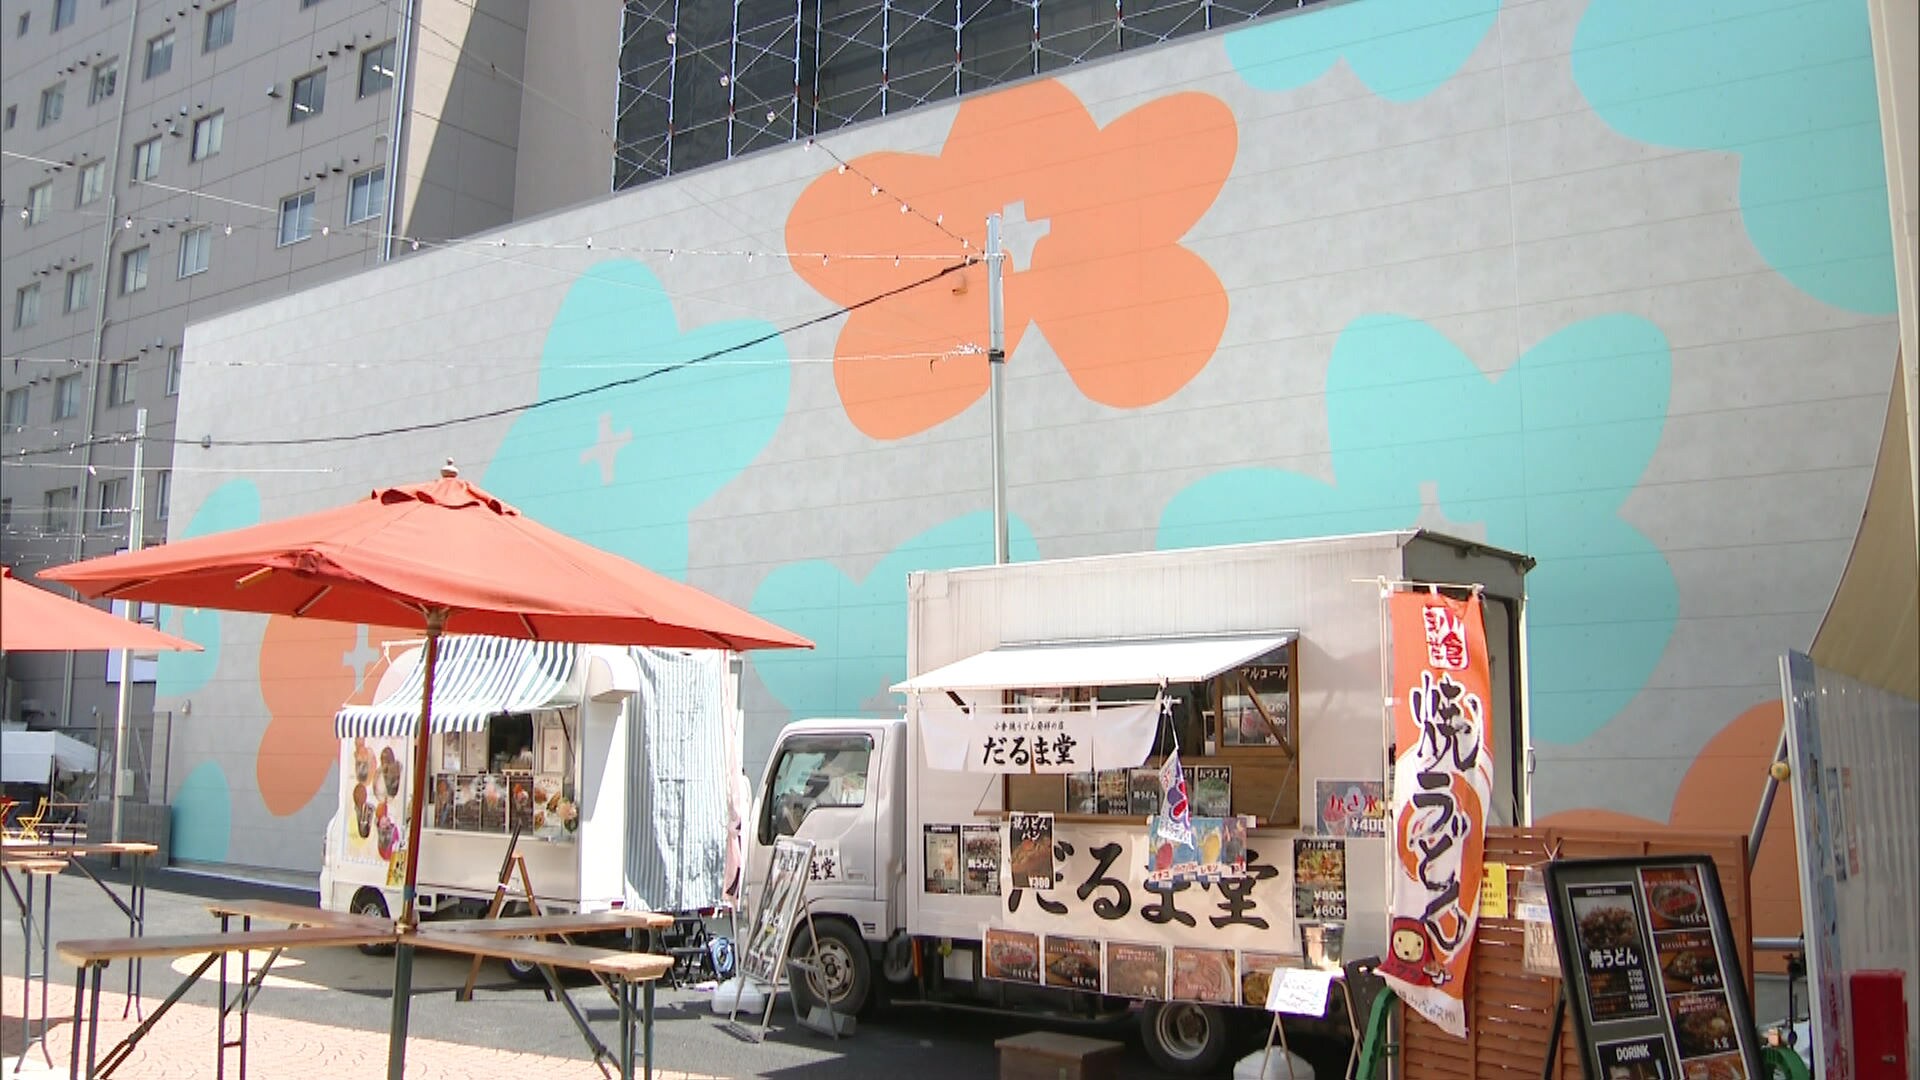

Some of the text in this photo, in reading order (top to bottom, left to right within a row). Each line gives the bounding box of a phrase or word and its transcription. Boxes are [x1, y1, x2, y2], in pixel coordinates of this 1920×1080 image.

[1241, 666, 1289, 681] アルコール
[983, 733, 1077, 766] だるま堂
[1412, 672, 1480, 951] 焼うどん
[1351, 817, 1385, 832] ¥400
[1021, 830, 1041, 840] パン
[1312, 904, 1344, 916] ¥600
[1589, 947, 1638, 968] 焼うどん
[1615, 1043, 1650, 1062] DORINK
